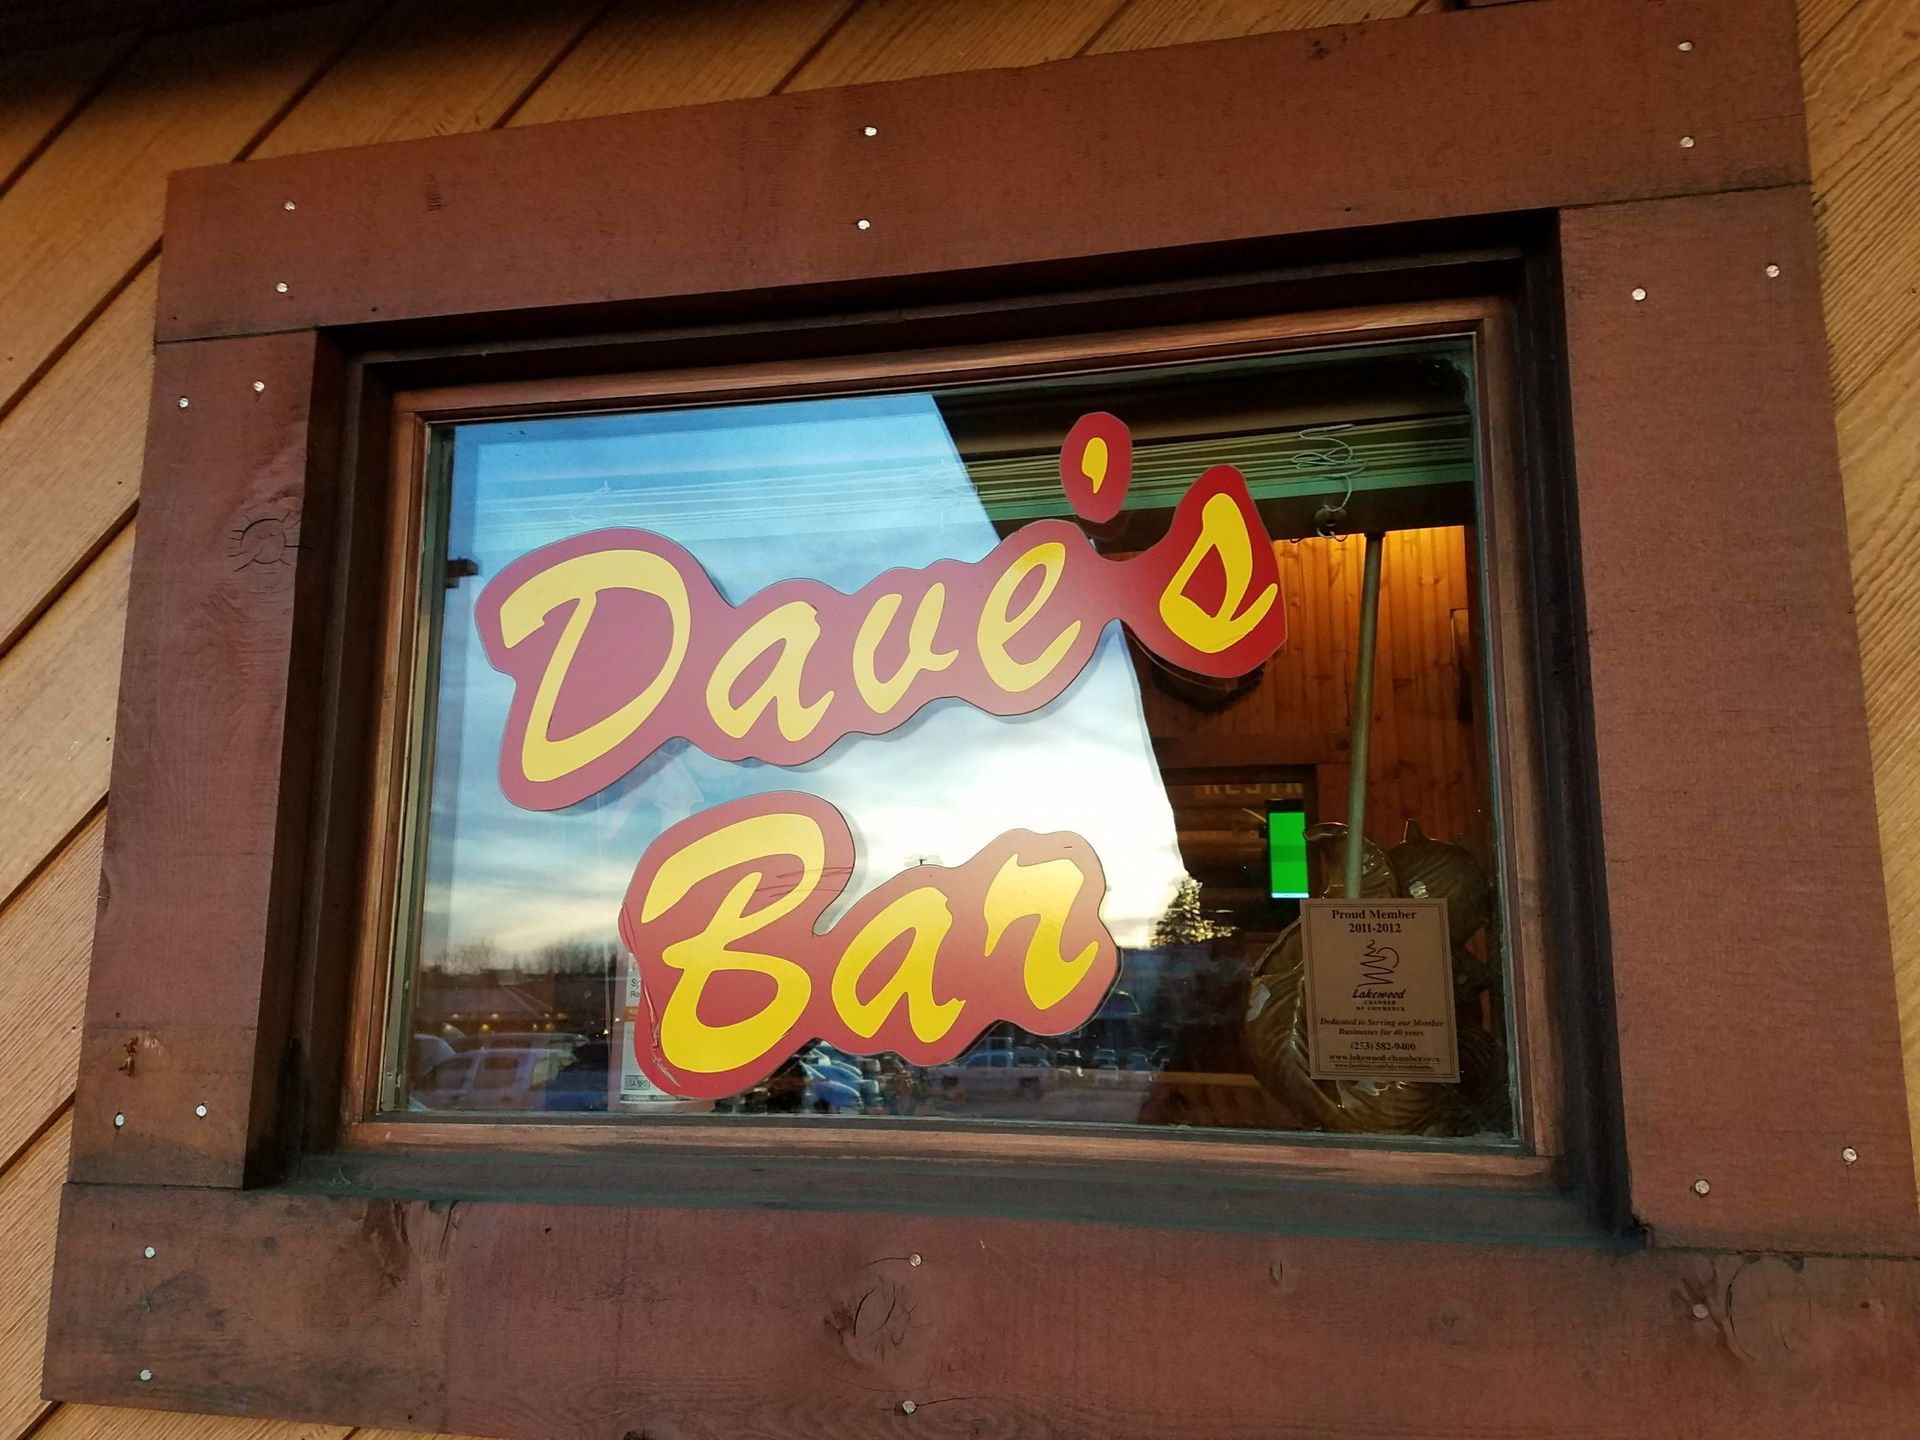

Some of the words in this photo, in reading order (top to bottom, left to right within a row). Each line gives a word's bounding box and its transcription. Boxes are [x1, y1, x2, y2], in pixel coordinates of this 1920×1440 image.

[500, 437, 1279, 783] Dave's
[1331, 909, 1366, 919] Proud
[1369, 909, 1417, 919] Member
[1349, 923, 1402, 933] 2011-2012
[641, 813, 1099, 1073] Bar
[1352, 988, 1407, 999] Lakewood
[1320, 1017, 1357, 1026] Dedicated
[1358, 1018, 1365, 1026] to
[1367, 1018, 1396, 1027] Serving
[1413, 1019, 1444, 1027] Member
[1338, 1028, 1378, 1036] Businesses
[1380, 1028, 1392, 1037] for
[1393, 1028, 1403, 1036] 40
[1350, 1041, 1374, 1051] (253)
[1375, 1041, 1416, 1051] 582-9400
